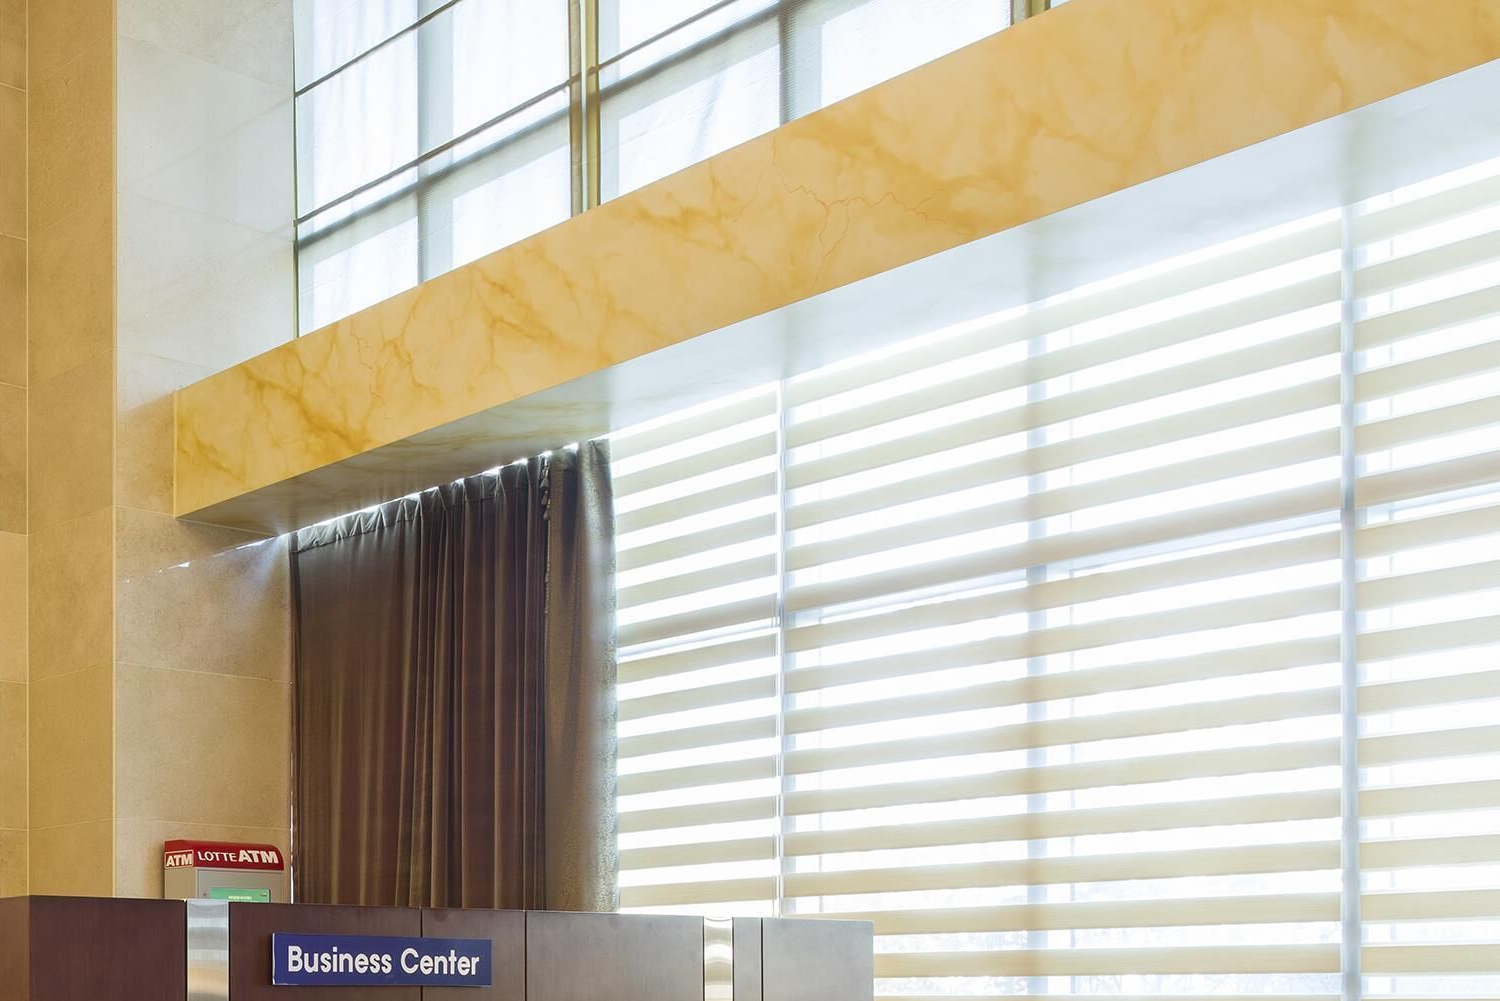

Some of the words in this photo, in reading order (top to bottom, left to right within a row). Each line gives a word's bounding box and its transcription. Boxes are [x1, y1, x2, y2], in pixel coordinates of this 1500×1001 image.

[166, 854, 193, 867] ATM
[198, 851, 237, 862] LOTTE
[238, 849, 279, 864] ATM
[288, 945, 392, 974] Business
[400, 948, 480, 976] Center
